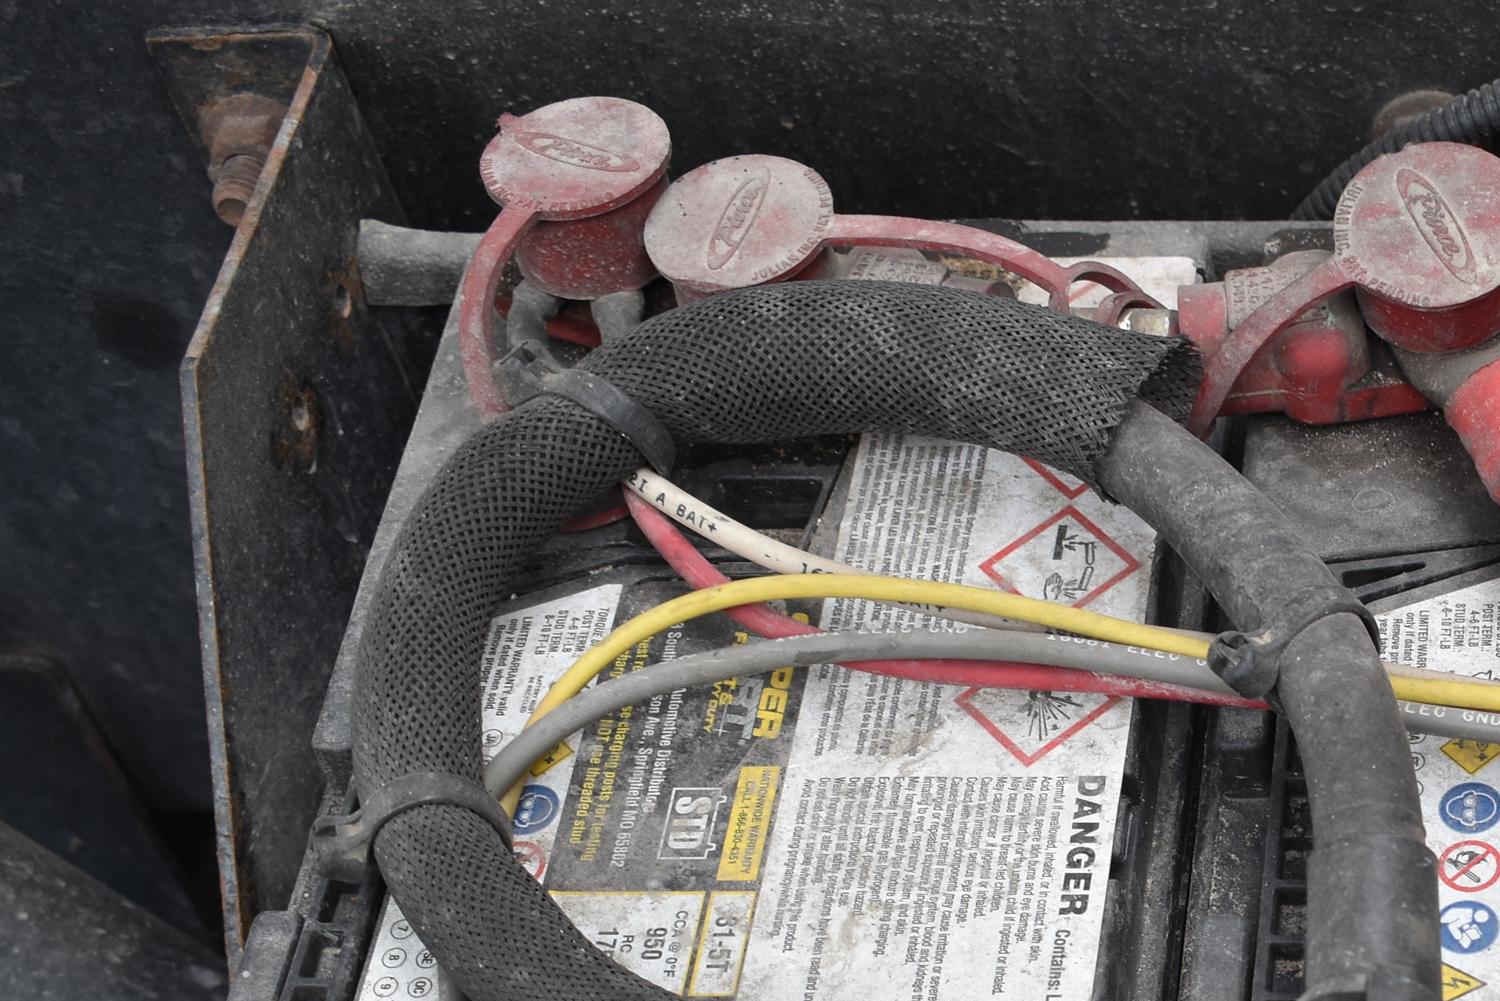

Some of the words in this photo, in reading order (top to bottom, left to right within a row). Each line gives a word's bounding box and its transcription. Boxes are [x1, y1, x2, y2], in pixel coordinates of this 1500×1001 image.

[655, 492, 667, 506] A
[675, 504, 718, 533] BAT+
[554, 610, 568, 629] STUD
[581, 610, 595, 628] POST
[592, 608, 610, 636] TORQUE
[1402, 613, 1414, 628] only
[1453, 603, 1466, 623] STUD
[1482, 604, 1493, 622] POST
[505, 619, 518, 634] only
[516, 616, 533, 647] LIMITED
[1391, 619, 1402, 649] Remove
[1418, 610, 1429, 642] LIMITED
[1468, 626, 1479, 646] FT-LB
[534, 634, 549, 655] FT-LB
[562, 632, 576, 652] FT-LB
[1440, 628, 1452, 649] FT-LB
[497, 644, 511, 666] dated
[1403, 639, 1414, 661] dated
[491, 669, 503, 690] when
[503, 650, 523, 694] WARRANTY
[484, 693, 497, 711] sold.
[496, 696, 508, 715] valid
[753, 667, 787, 738] PER
[595, 719, 613, 741] NOT
[590, 745, 603, 763] use
[625, 748, 651, 805] Springfield
[1040, 776, 1051, 791] Acid
[576, 767, 600, 816] threaded
[752, 770, 771, 822] NATIONWIDE
[1053, 776, 1067, 803] Harmful
[1035, 793, 1047, 817] causes
[620, 810, 637, 828] MO
[669, 796, 711, 849] STD
[1032, 818, 1043, 841] severe
[1045, 812, 1060, 850] swallowed,
[610, 833, 631, 867] 65802
[741, 825, 760, 874] WARRANTY
[1029, 844, 1041, 858] skin
[1060, 775, 1105, 915] DANGER
[1026, 860, 1038, 880] burns
[1023, 882, 1034, 895] and
[1019, 897, 1031, 910] eye
[1034, 899, 1047, 926] contact
[672, 911, 688, 937] CCA
[1014, 912, 1030, 943] damage.
[620, 935, 634, 952] RC
[641, 927, 667, 959] 950
[1032, 928, 1043, 943] with
[1028, 945, 1041, 963] skin.
[1048, 930, 1070, 990] Contains:
